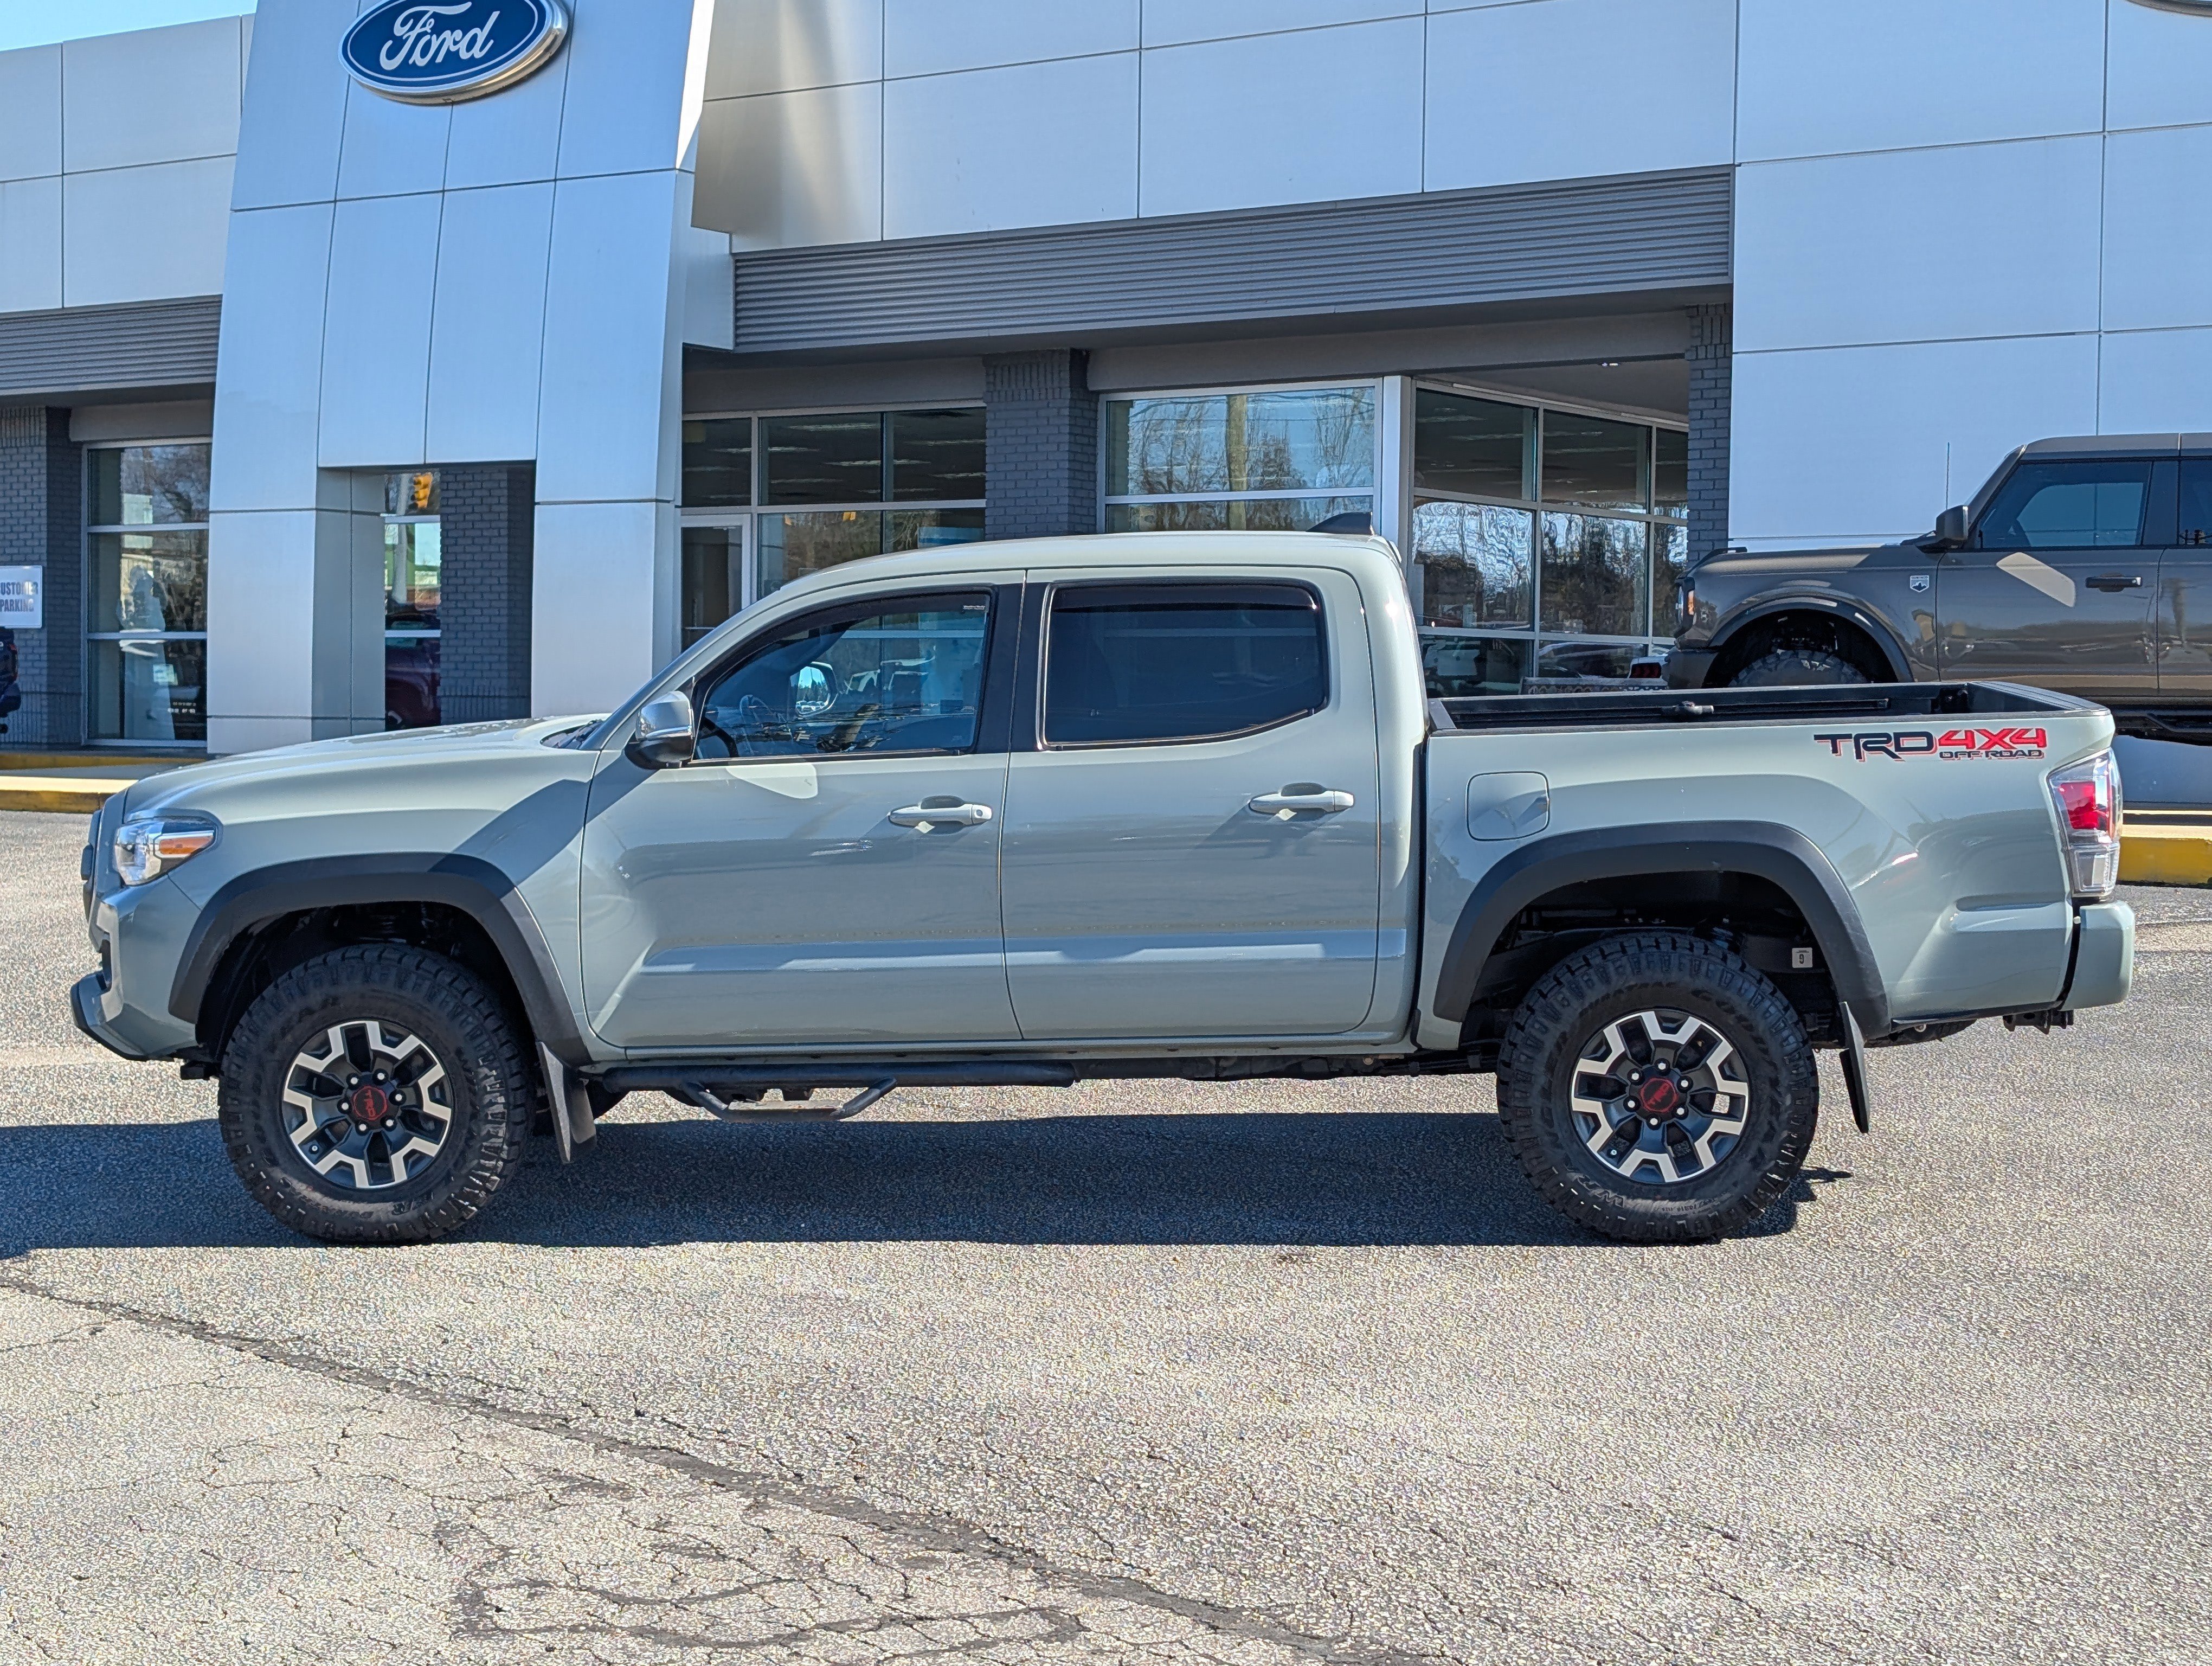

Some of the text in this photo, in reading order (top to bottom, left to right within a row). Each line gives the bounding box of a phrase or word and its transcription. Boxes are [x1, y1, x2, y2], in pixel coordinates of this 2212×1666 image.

[379, 1, 500, 71] Ford
[0, 581, 38, 595] USTOMER
[0, 598, 34, 613] PARKING
[1814, 731, 1938, 762] TRD
[1939, 749, 2044, 760] OFF ROAD
